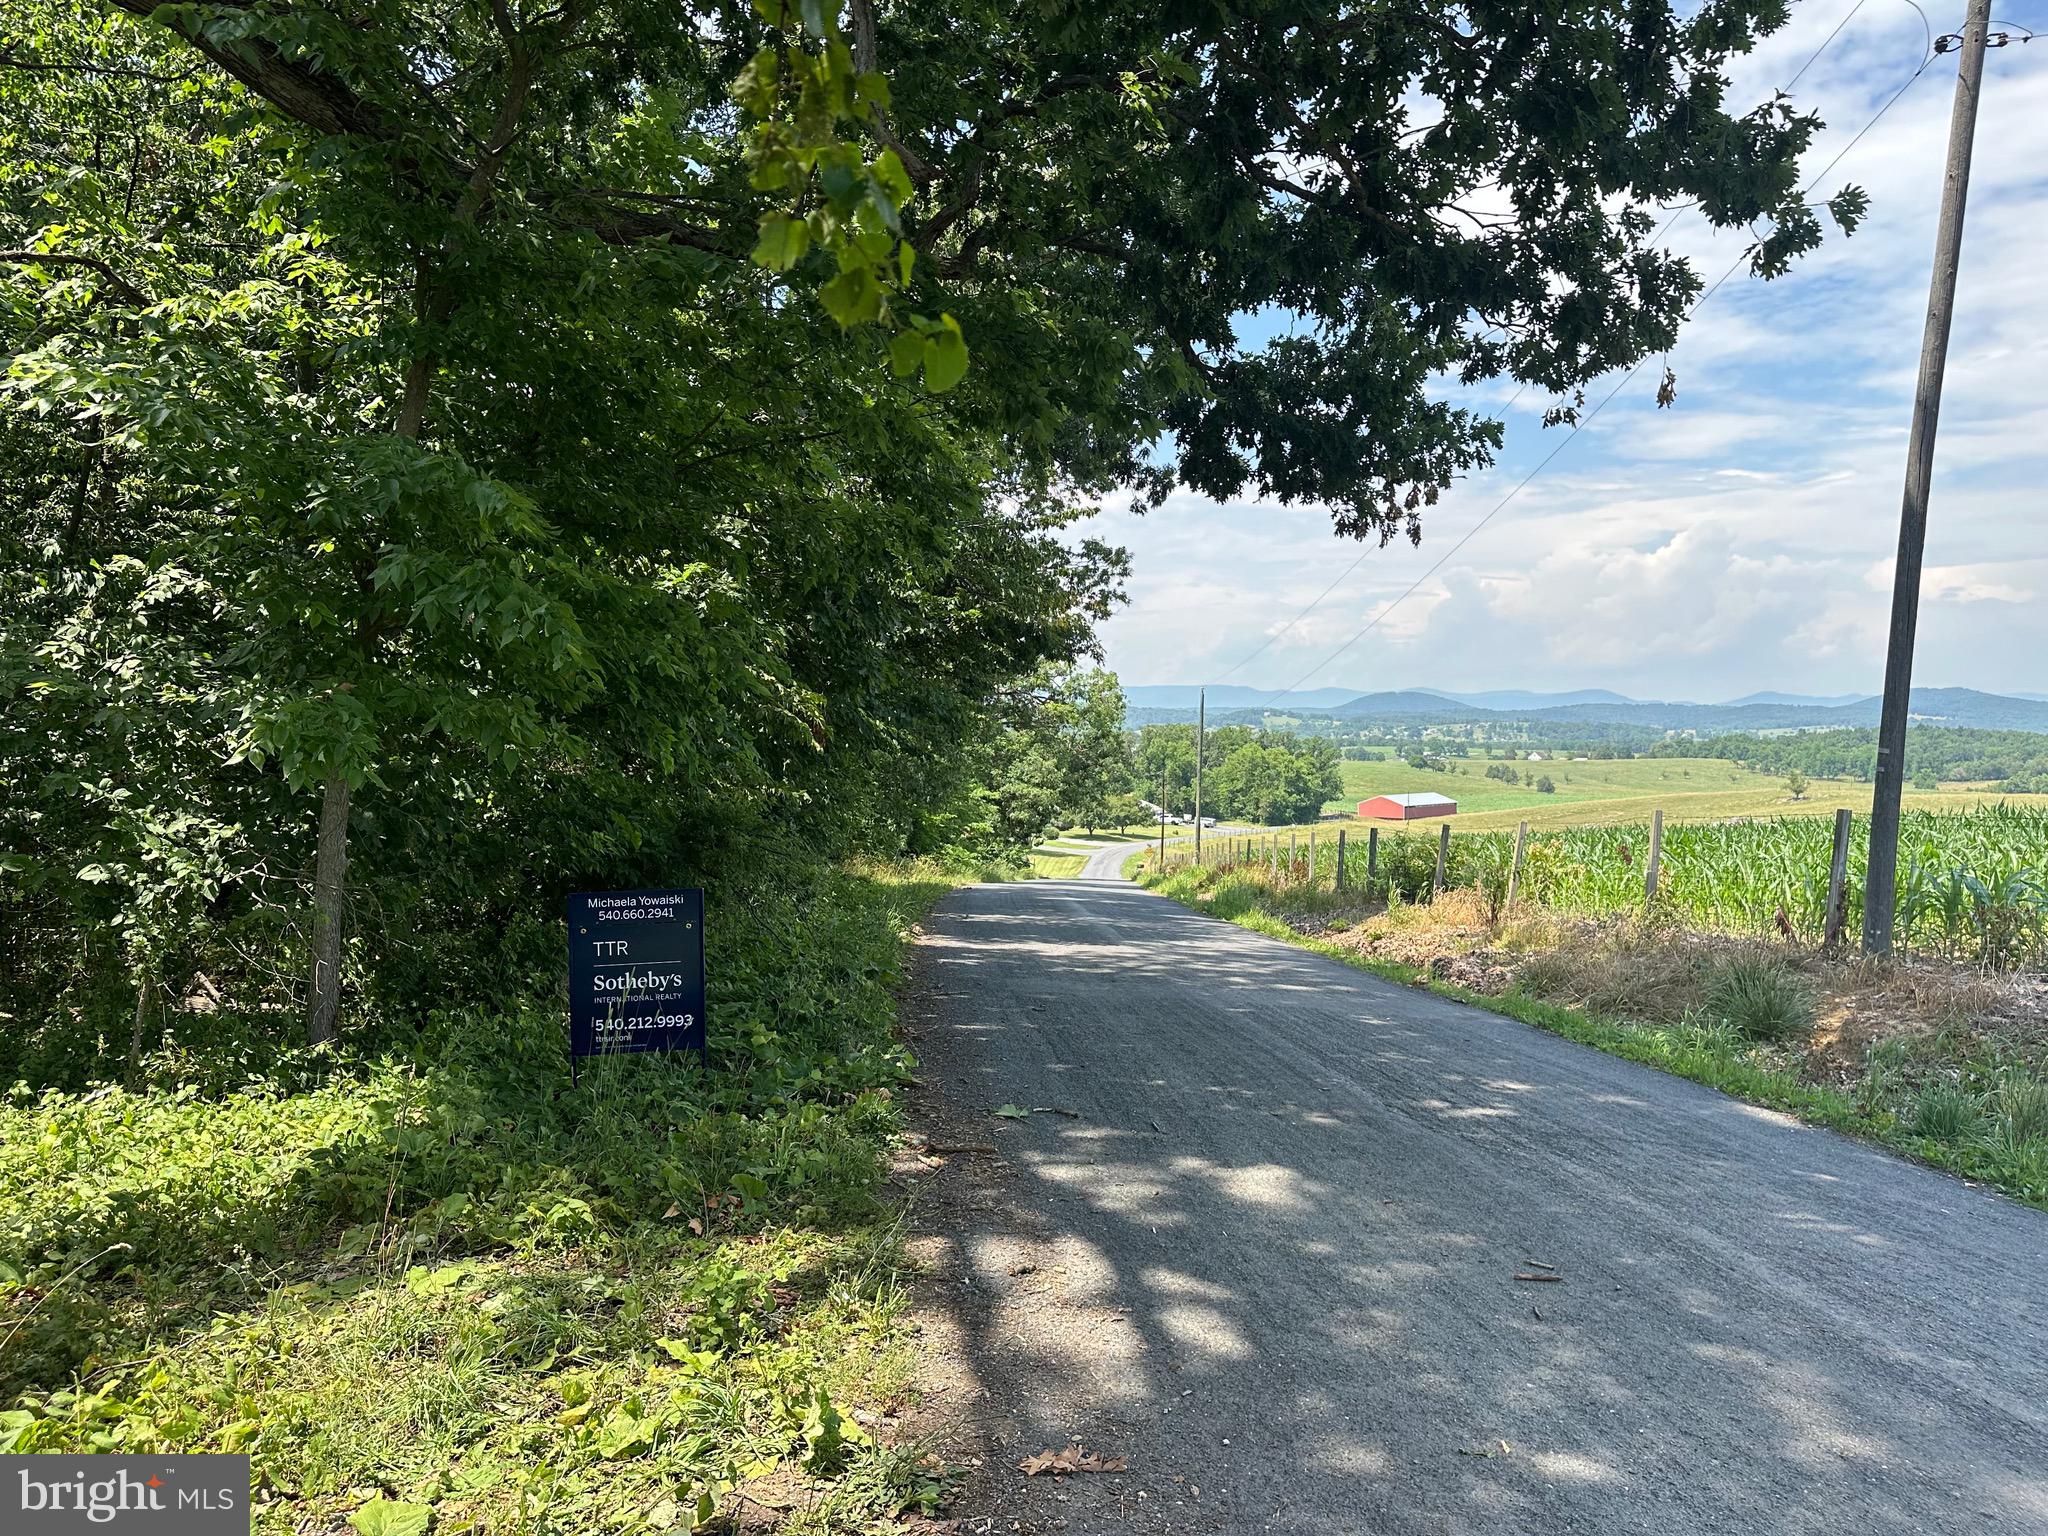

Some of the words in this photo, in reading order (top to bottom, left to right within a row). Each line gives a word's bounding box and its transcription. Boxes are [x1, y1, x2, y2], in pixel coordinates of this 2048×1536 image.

[588, 897, 636, 908] Michaela
[598, 907, 674, 921] 540.660.2941
[592, 940, 629, 957] TTR
[593, 970, 682, 991] Sotheby's
[655, 993, 682, 1001] REALTY
[595, 1014, 693, 1032] 540.212.9993
